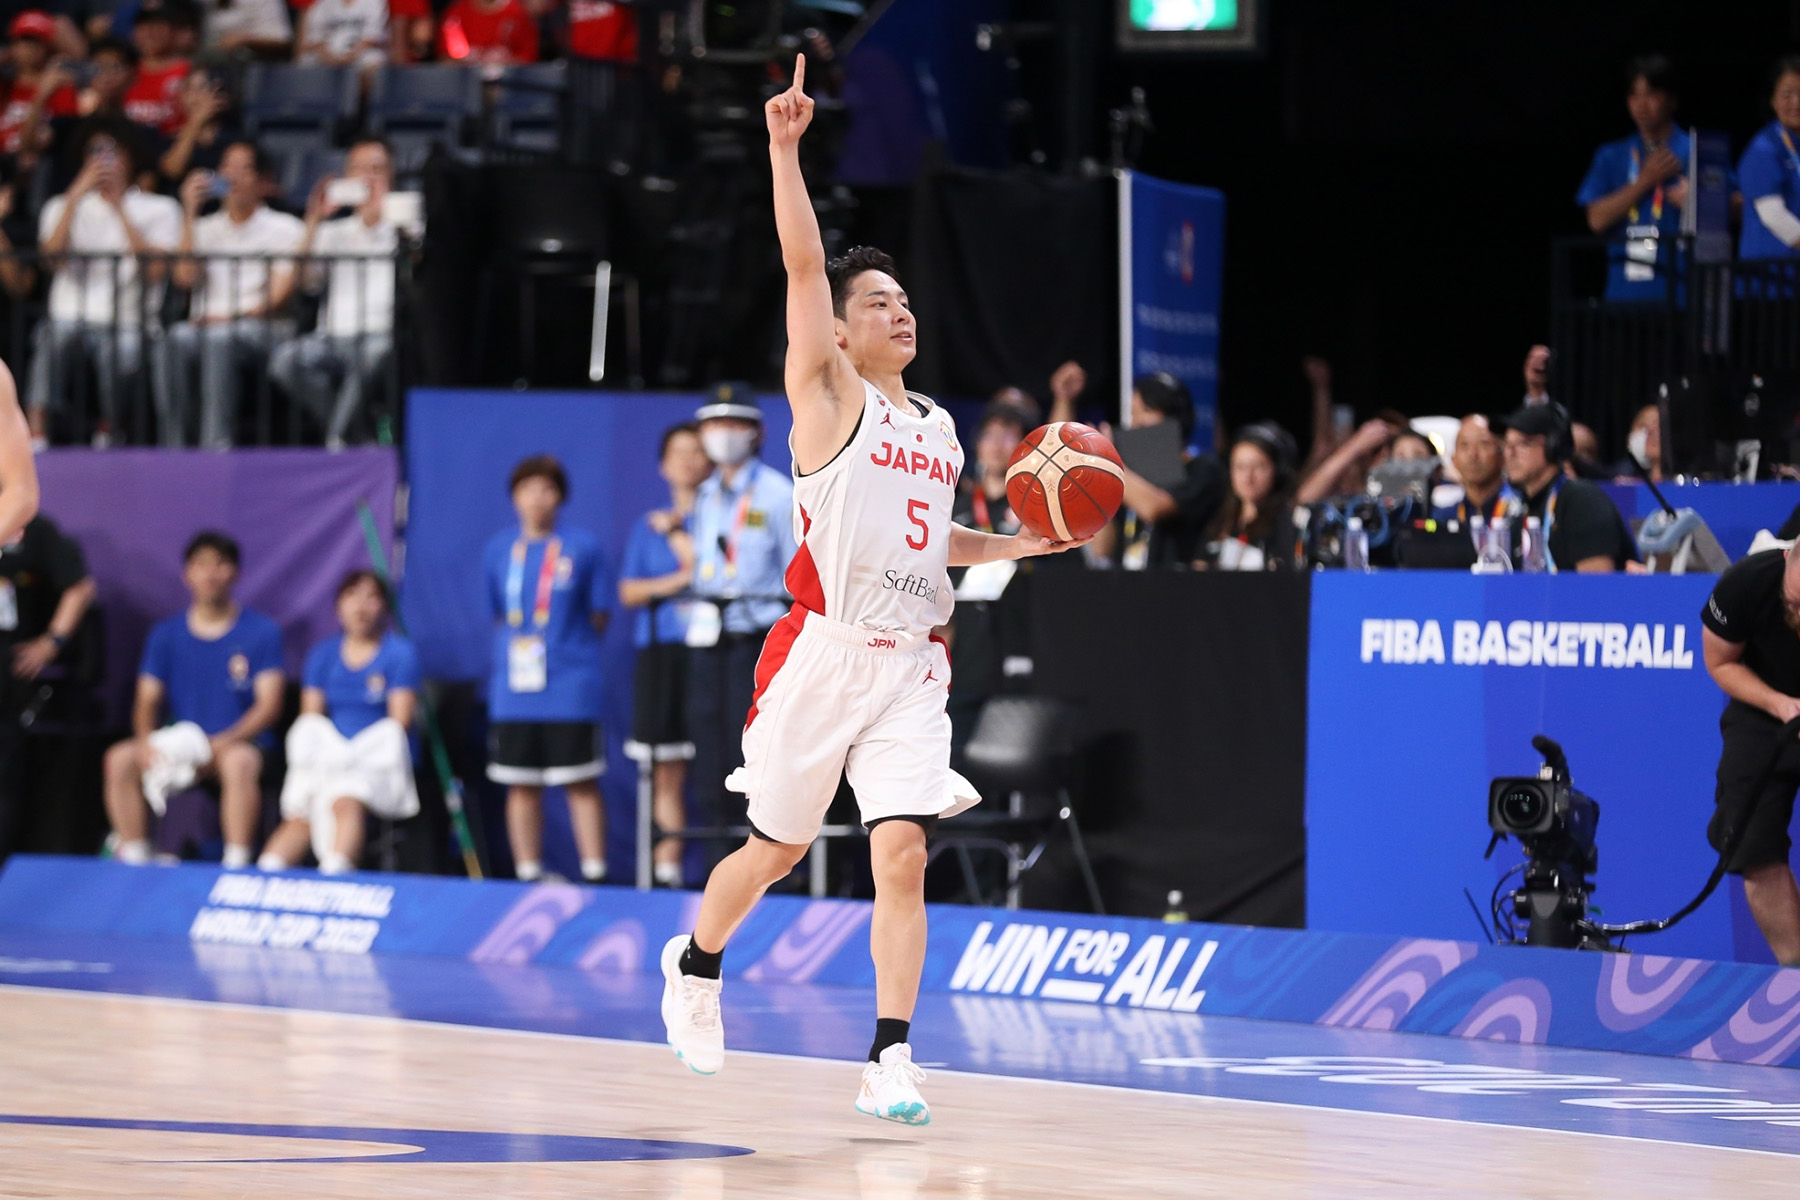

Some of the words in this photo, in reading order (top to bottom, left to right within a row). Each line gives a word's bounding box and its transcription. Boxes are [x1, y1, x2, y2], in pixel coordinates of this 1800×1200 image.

[870, 441, 958, 488] JAPAN
[906, 498, 929, 551] 5
[867, 637, 896, 649] JPN
[1360, 618, 1446, 665] FIBA
[1452, 620, 1694, 670] BASKETBALL
[949, 921, 1068, 996] WIN
[1054, 928, 1130, 977] FOR
[1103, 934, 1219, 1014] ALL
